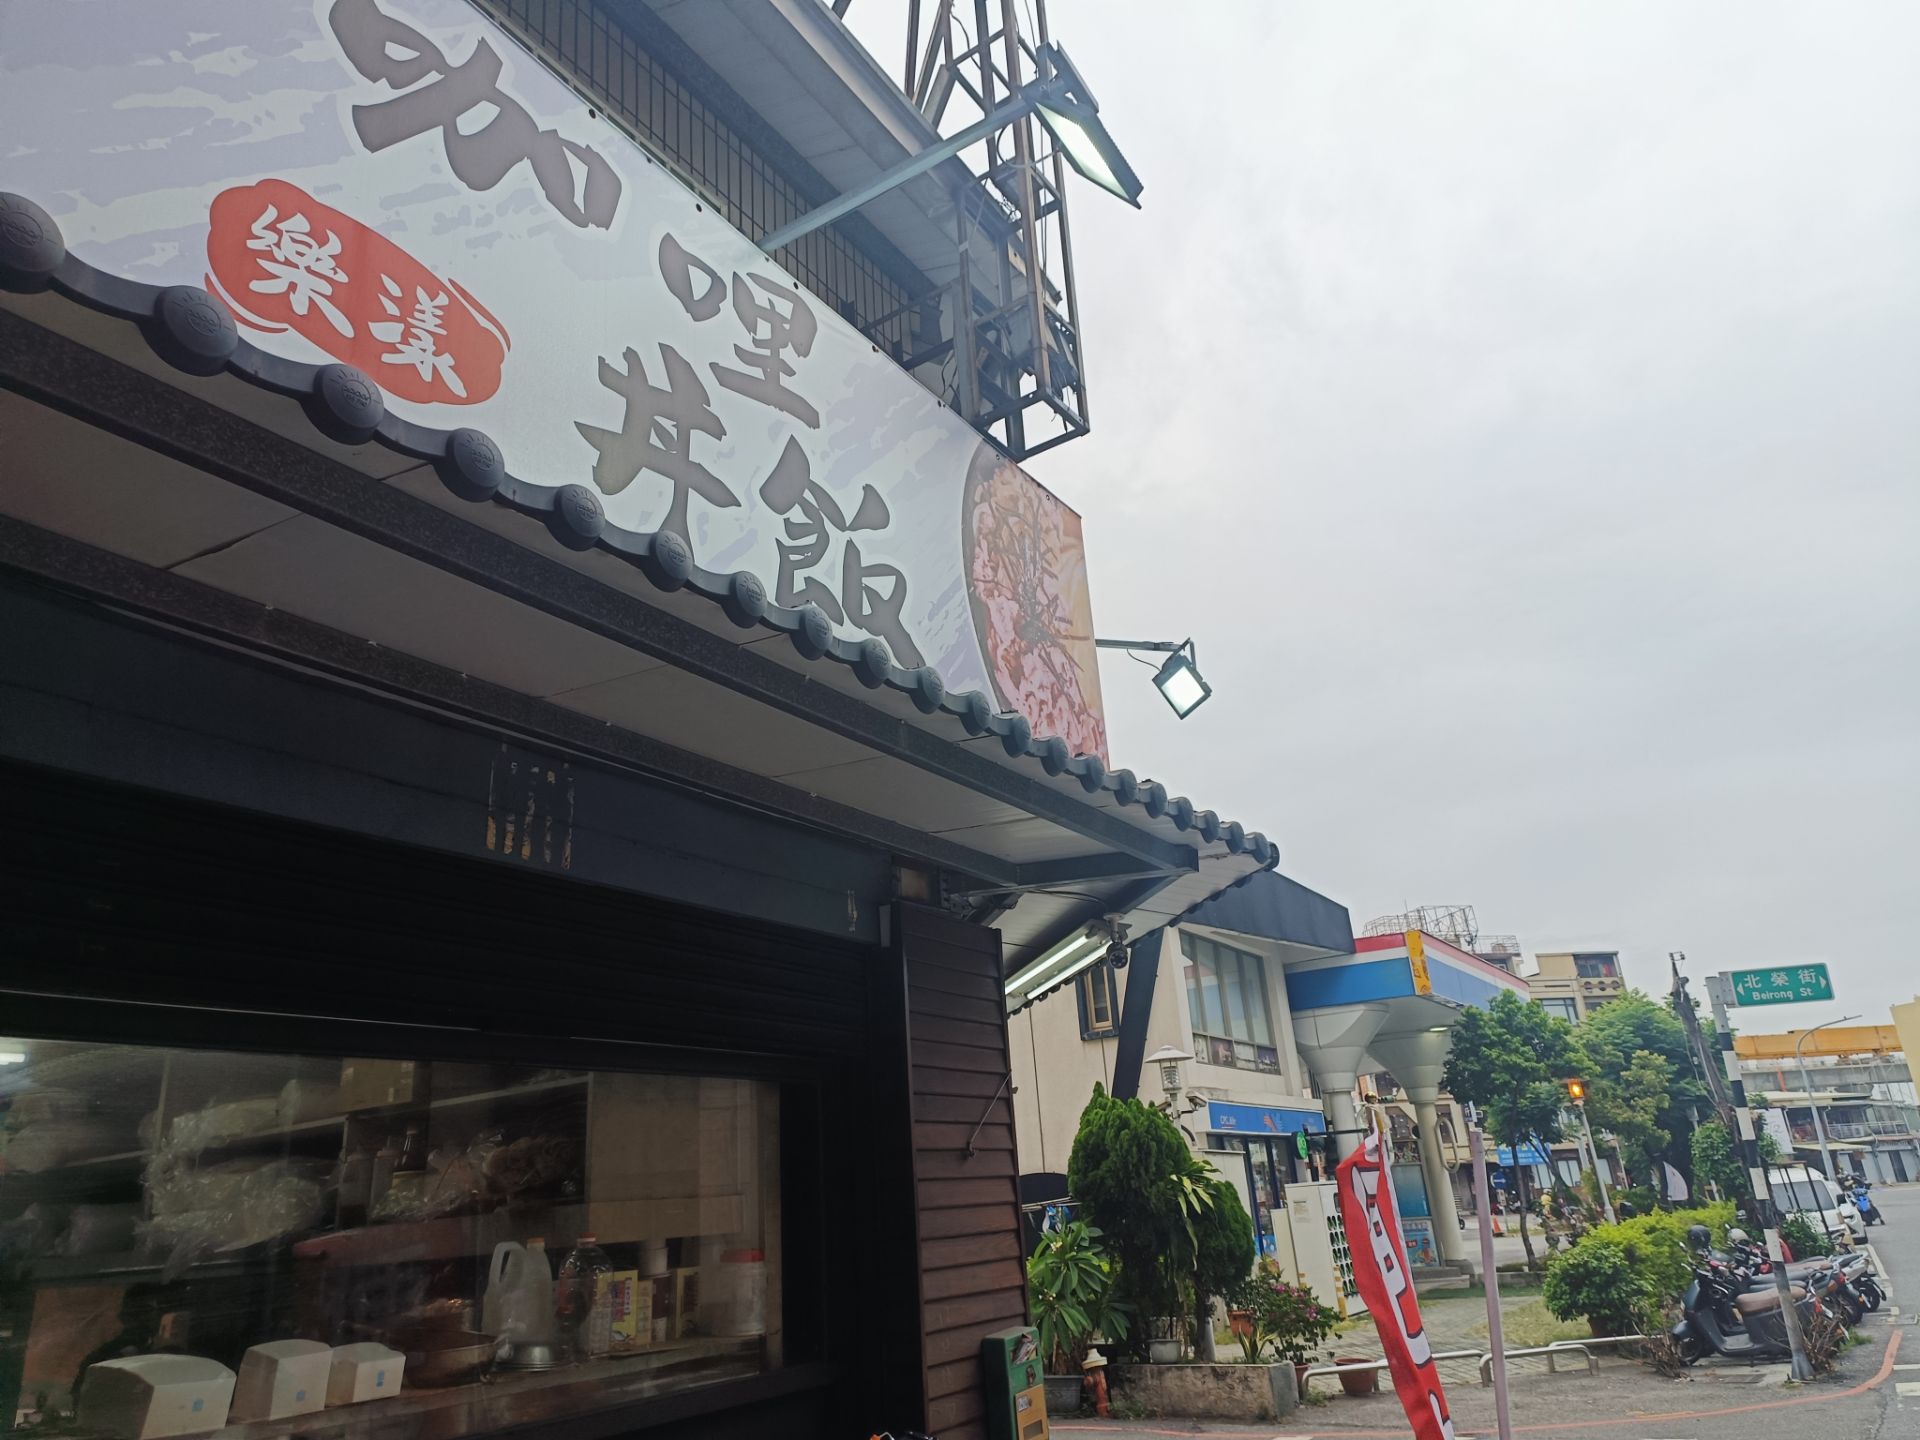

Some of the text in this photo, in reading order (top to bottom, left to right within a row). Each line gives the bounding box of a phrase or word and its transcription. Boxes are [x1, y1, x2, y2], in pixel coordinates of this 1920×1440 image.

[246, 203, 467, 398] 樂漾
[1744, 969, 1816, 988] 北榮街
[1753, 990, 1793, 1000] Beirong
